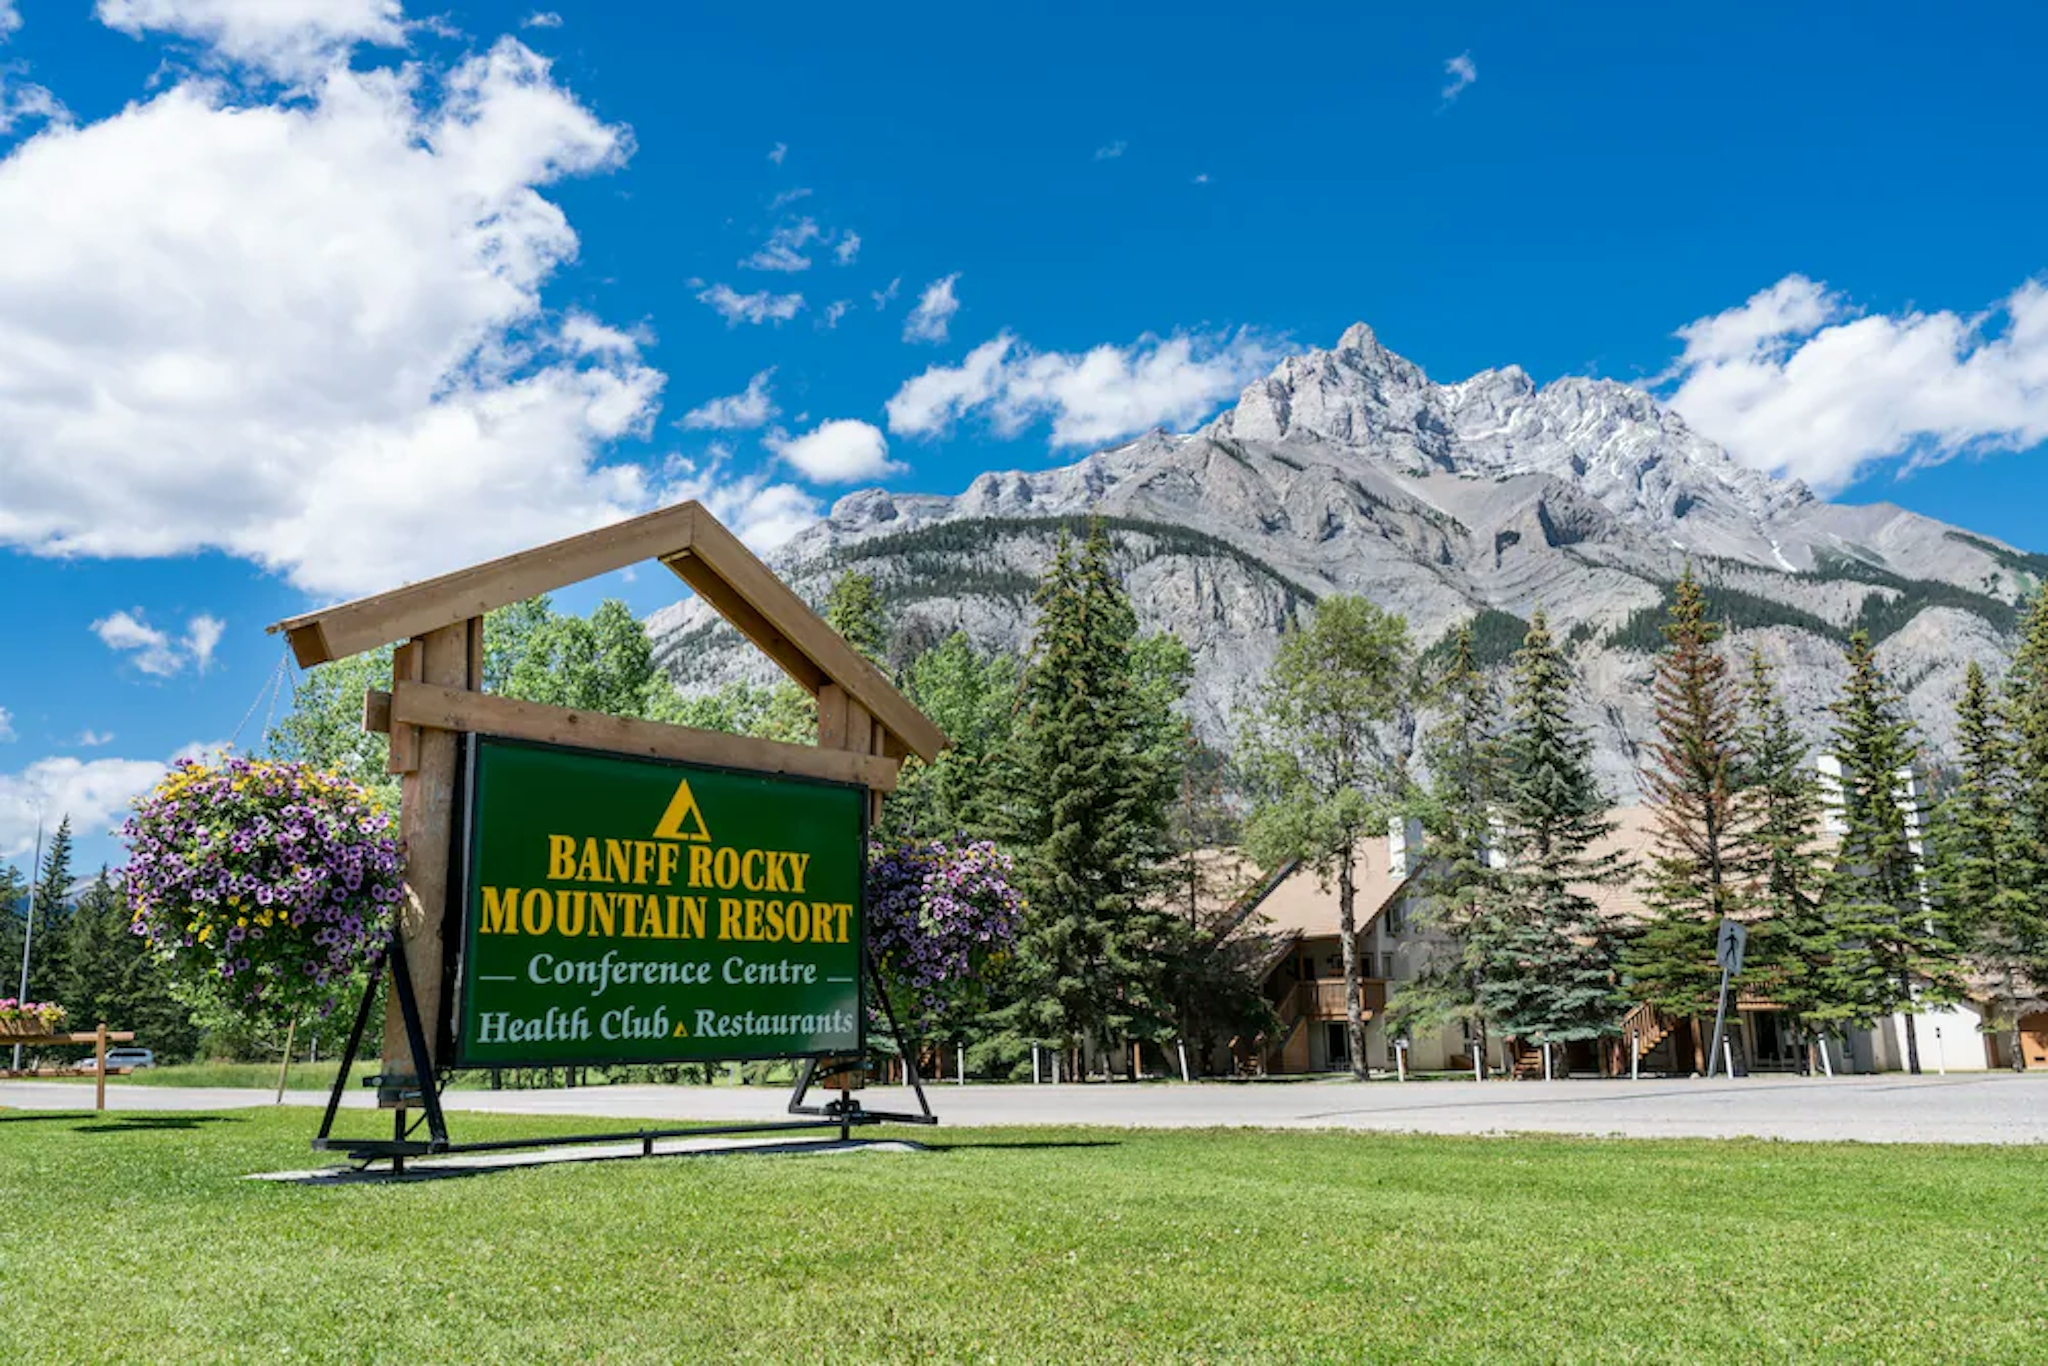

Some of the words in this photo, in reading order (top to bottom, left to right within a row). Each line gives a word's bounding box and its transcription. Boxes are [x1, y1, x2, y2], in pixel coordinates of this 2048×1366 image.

[547, 834, 680, 886] BANFF
[687, 844, 810, 894] ROCKY
[479, 886, 706, 940] MOUNTAIN
[717, 898, 853, 943] RESORT
[528, 950, 712, 996] Conference
[722, 956, 818, 985] Centre
[477, 1006, 592, 1044] Health
[600, 1005, 669, 1041] Club
[693, 1008, 853, 1038] Restaurants
